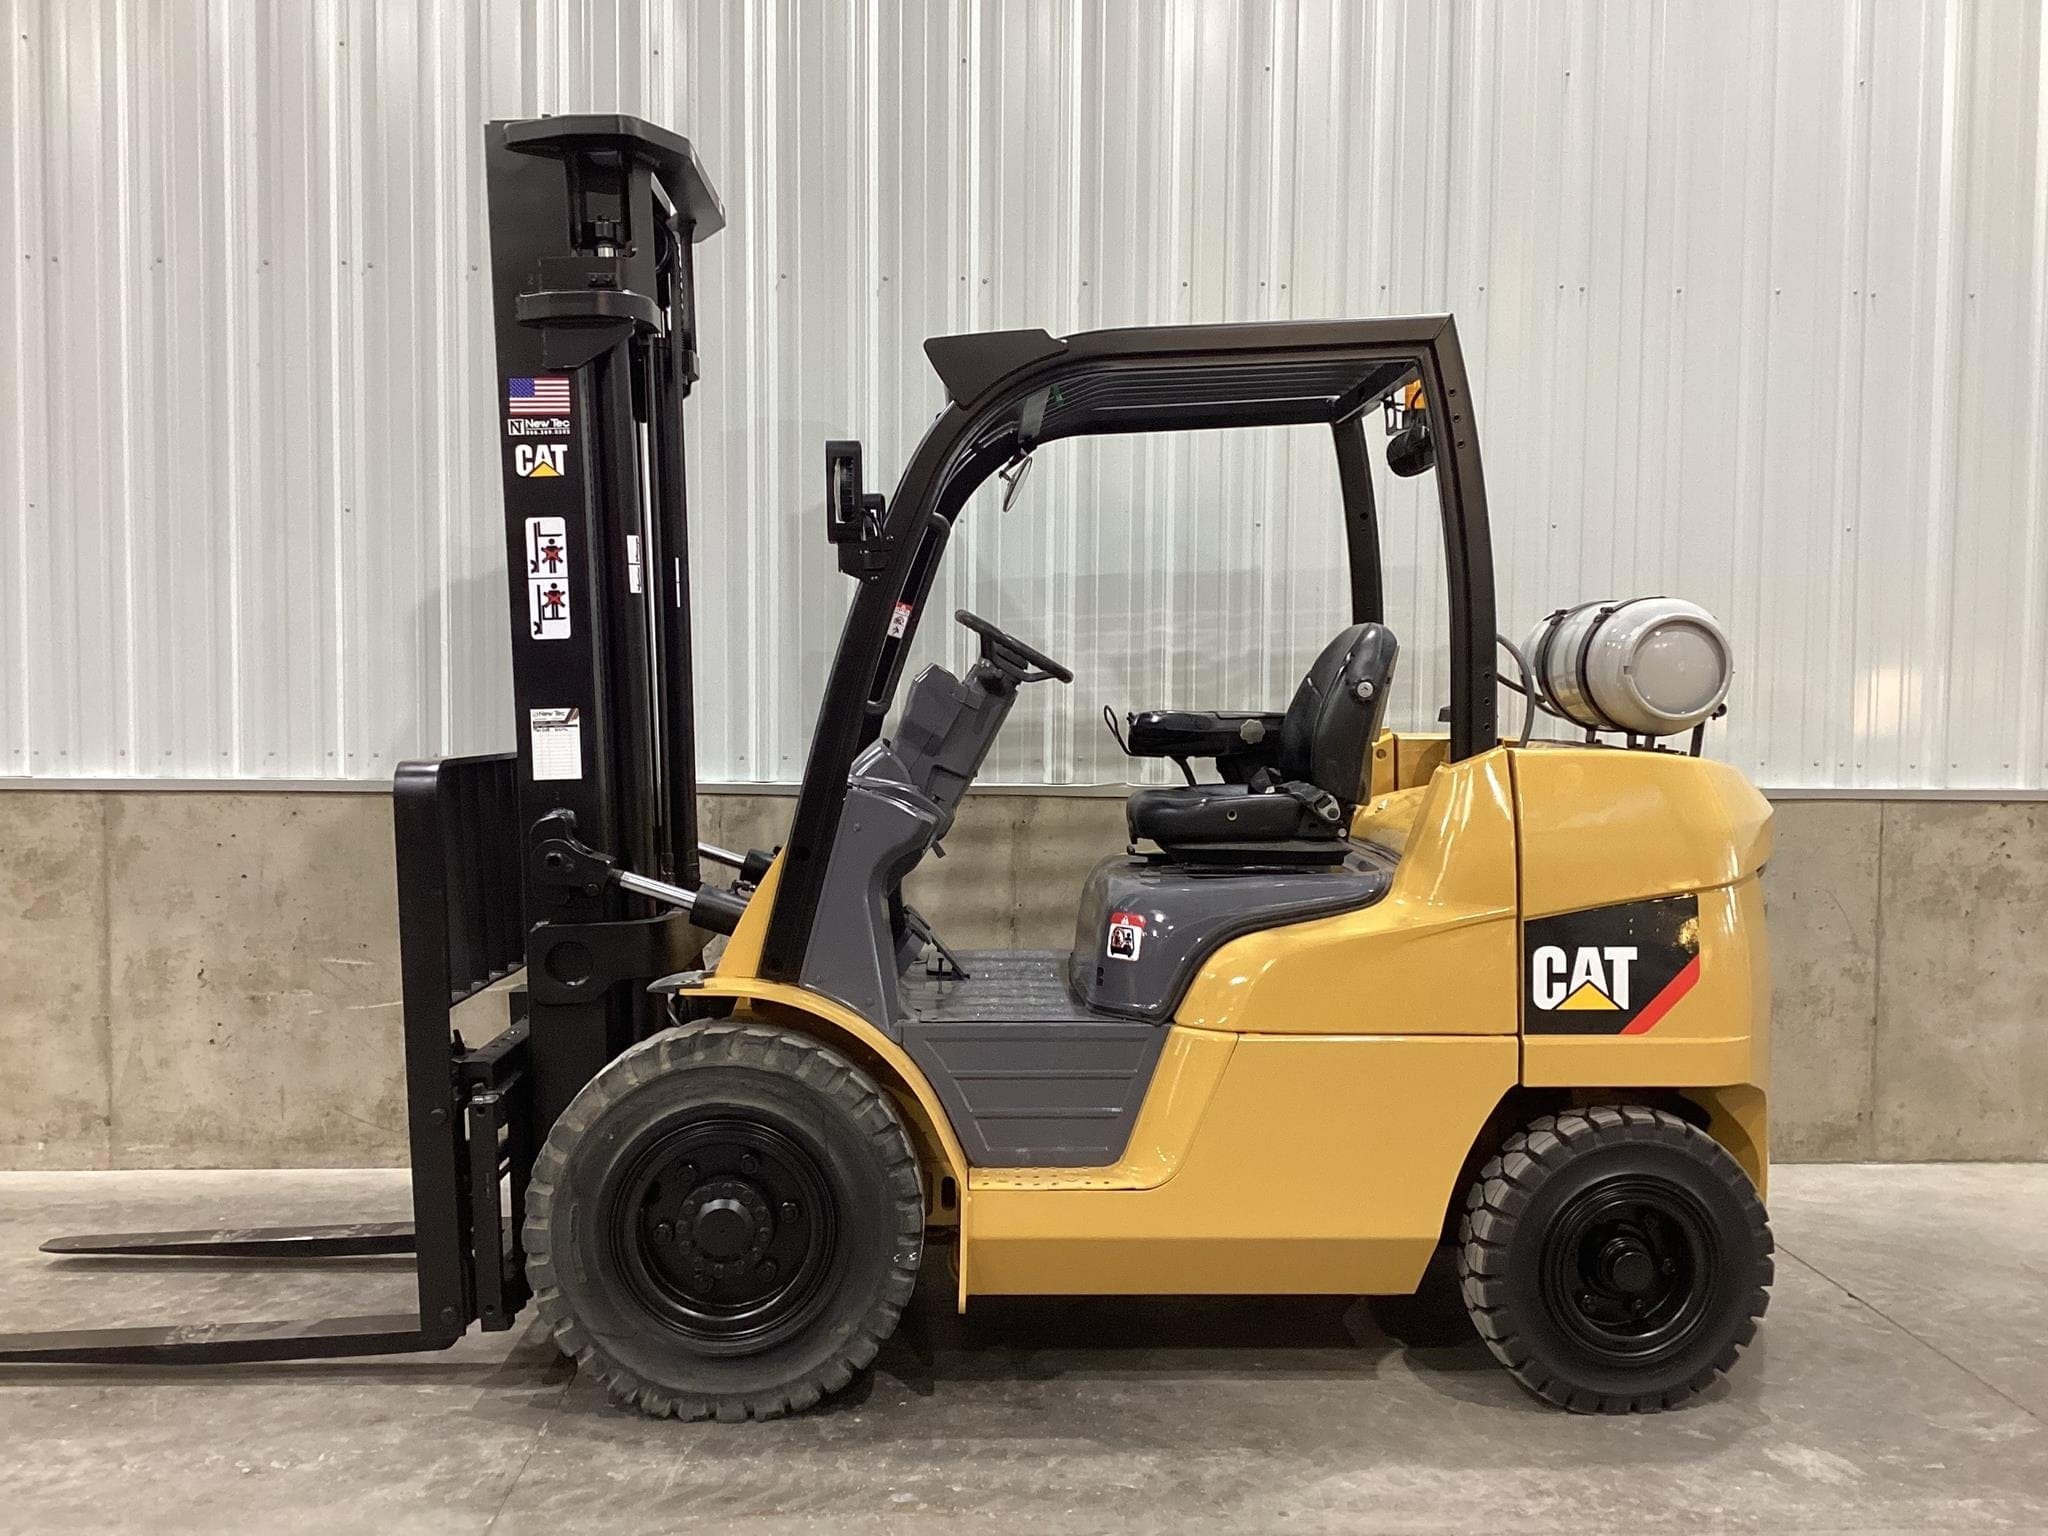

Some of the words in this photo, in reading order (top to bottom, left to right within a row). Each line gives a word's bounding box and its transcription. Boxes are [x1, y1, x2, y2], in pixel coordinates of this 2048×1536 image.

[525, 419, 550, 428] New
[550, 418, 570, 428] Tec
[515, 444, 568, 477] CAT
[1532, 945, 1638, 1010] CAT
